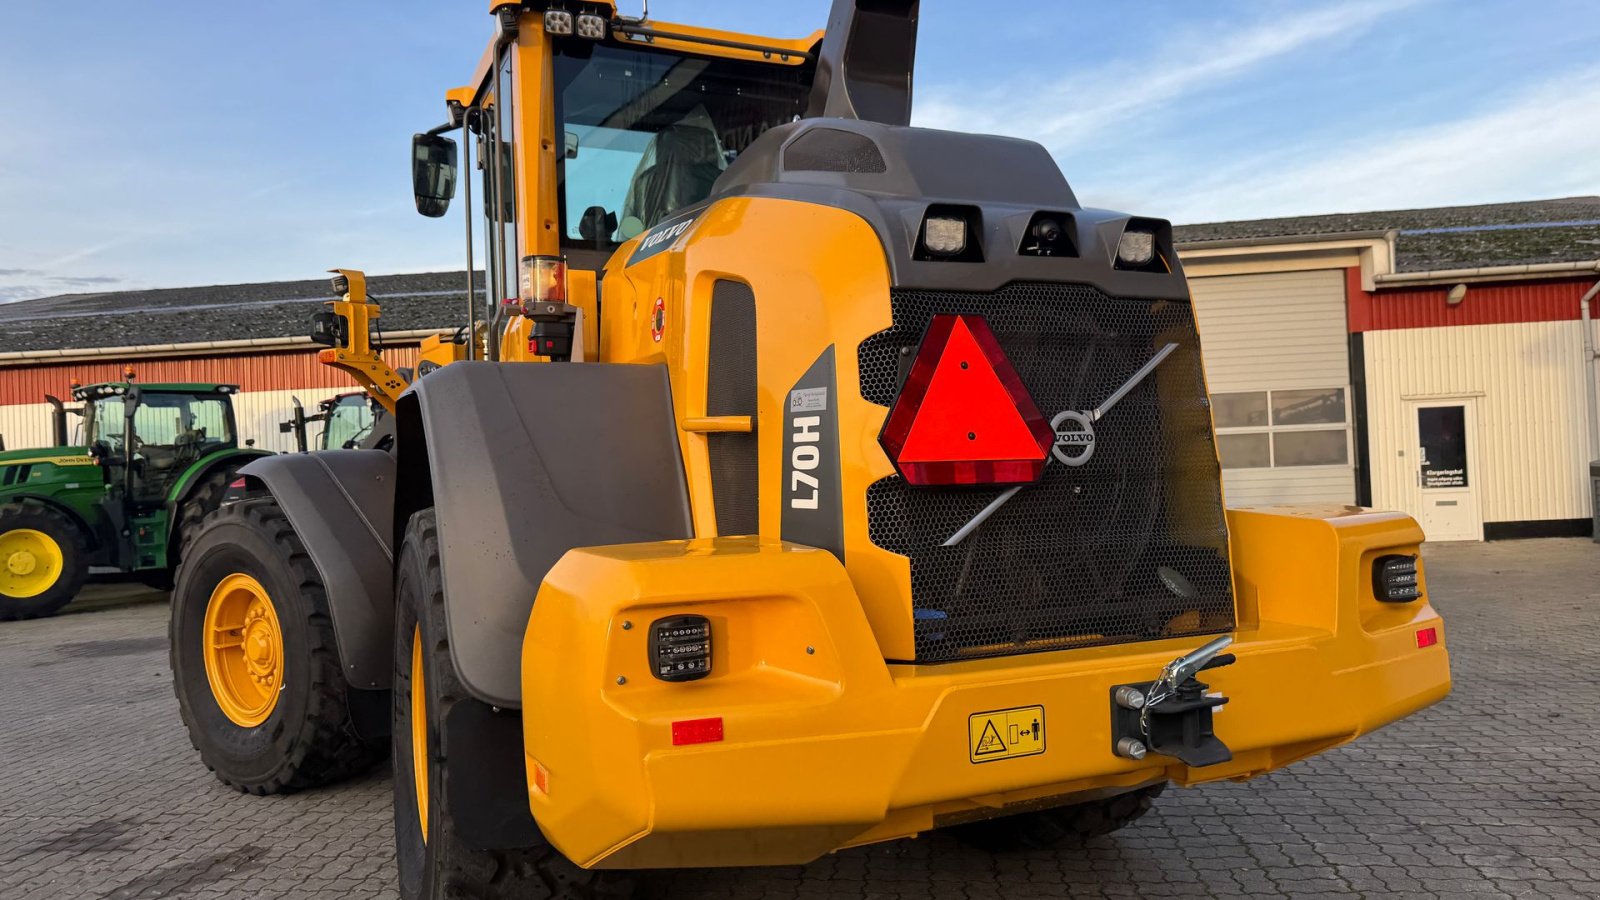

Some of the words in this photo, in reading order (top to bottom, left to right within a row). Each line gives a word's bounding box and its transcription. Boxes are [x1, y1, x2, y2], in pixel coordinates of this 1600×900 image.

[640, 219, 694, 252] VOLVO
[1055, 434, 1094, 442] VOLVO
[791, 415, 820, 510] L70H
